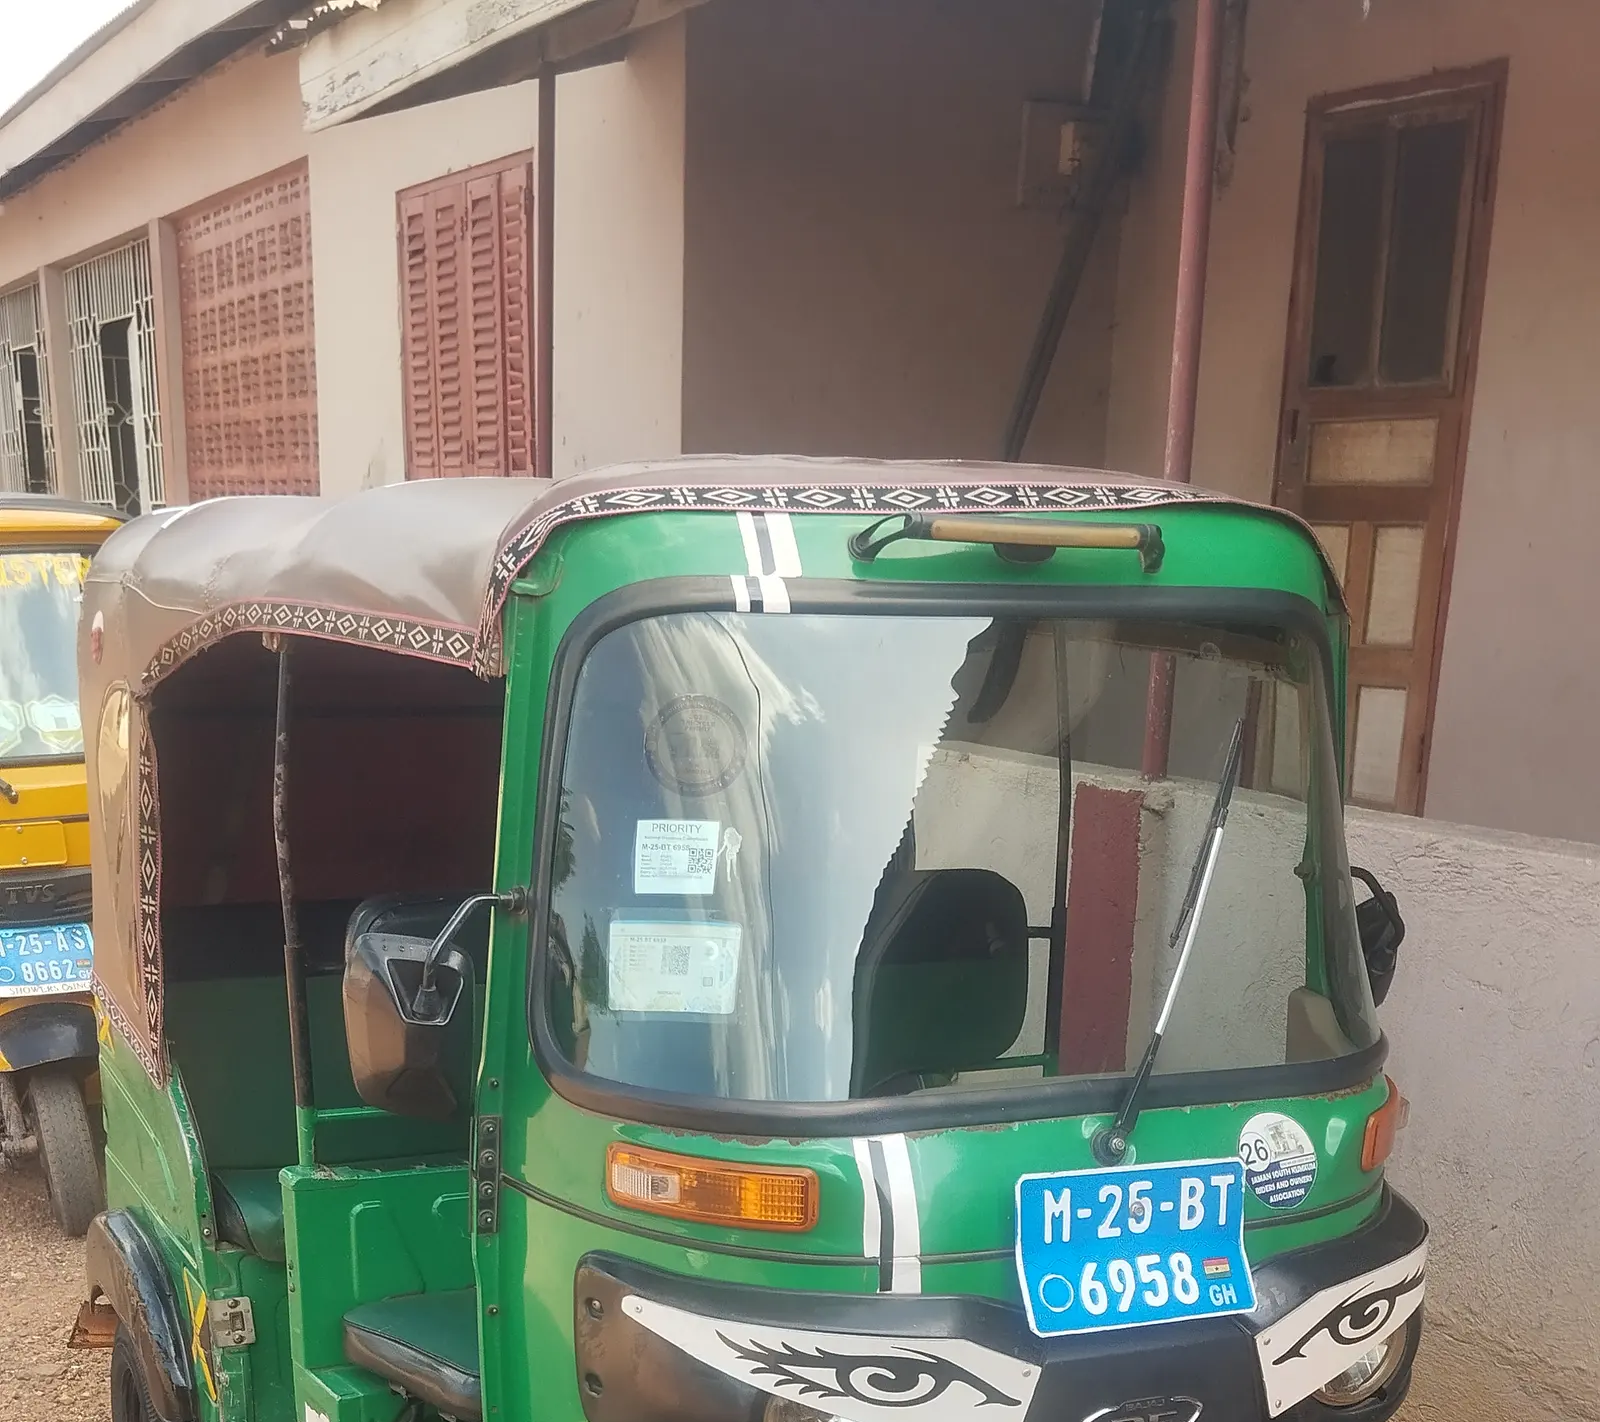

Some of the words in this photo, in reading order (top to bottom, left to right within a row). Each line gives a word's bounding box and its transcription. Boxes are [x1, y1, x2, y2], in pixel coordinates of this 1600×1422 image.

[652, 823, 702, 834] PRIORITY
[5, 883, 55, 905] TVS
[21, 958, 76, 983] 8662
[1240, 1138, 1268, 1166] 26
[1272, 1167, 1292, 1179] SOUTH
[1255, 1183, 1276, 1195] RIDERS
[1276, 1179, 1289, 1190] AND
[1269, 1188, 1305, 1204] ASSOCIATION
[1043, 1174, 1235, 1245] M-25-BT
[1079, 1252, 1200, 1316] 6958
[1208, 1283, 1238, 1307] GH
